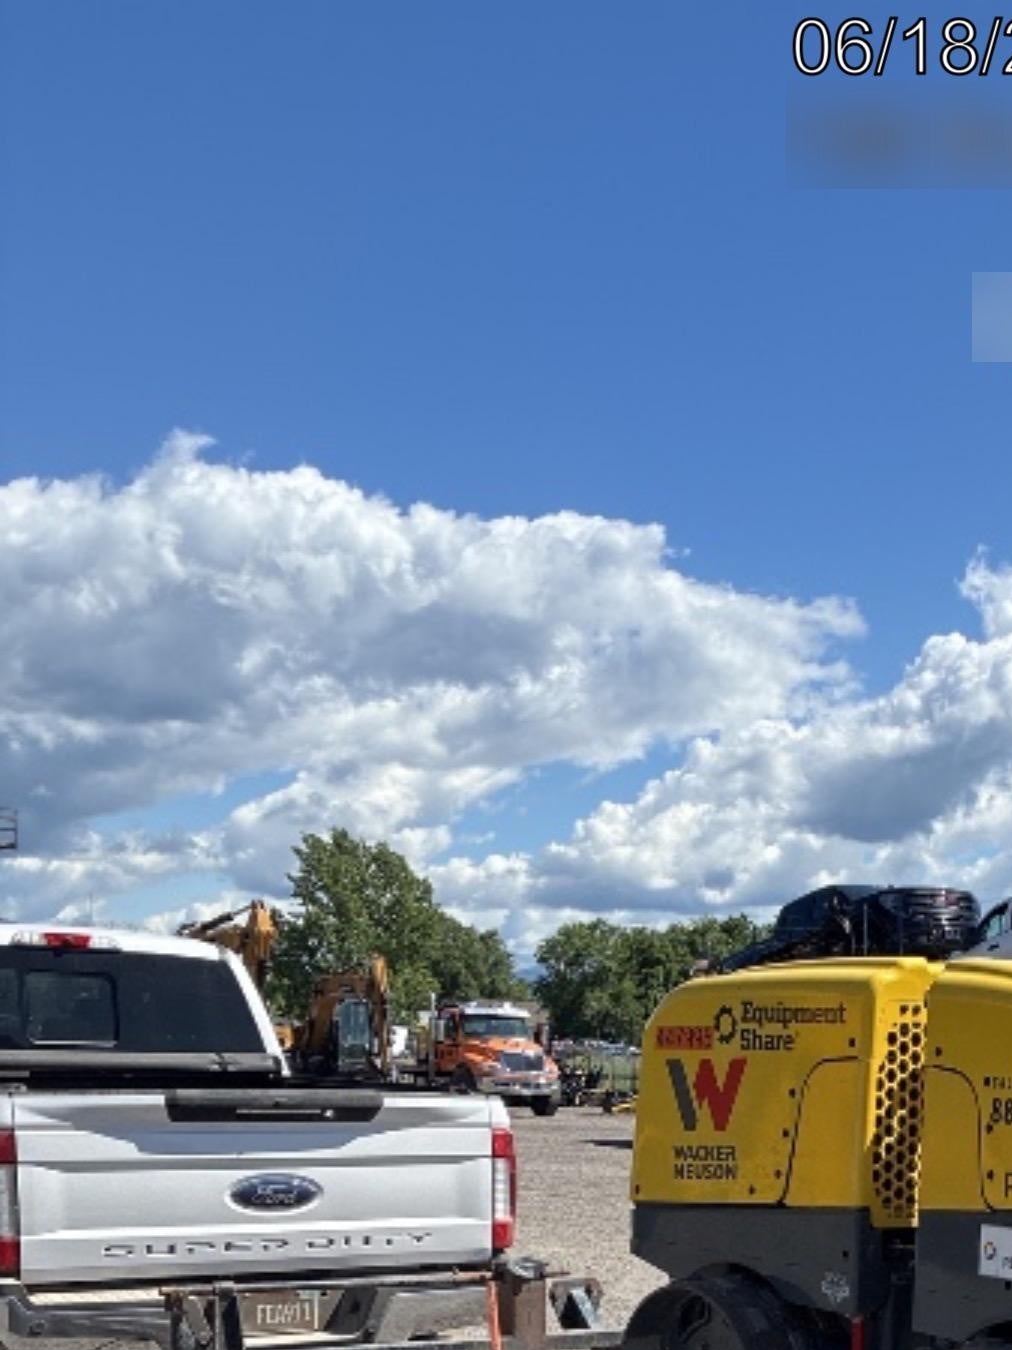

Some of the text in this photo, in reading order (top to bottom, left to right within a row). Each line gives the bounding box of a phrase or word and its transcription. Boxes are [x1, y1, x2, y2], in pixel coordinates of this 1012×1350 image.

[741, 1001, 847, 1028] Equipment
[741, 1028, 795, 1051] Share
[673, 1145, 736, 1161] WACKER
[673, 1163, 738, 1180] NEUSON
[103, 1238, 290, 1257] SUPER
